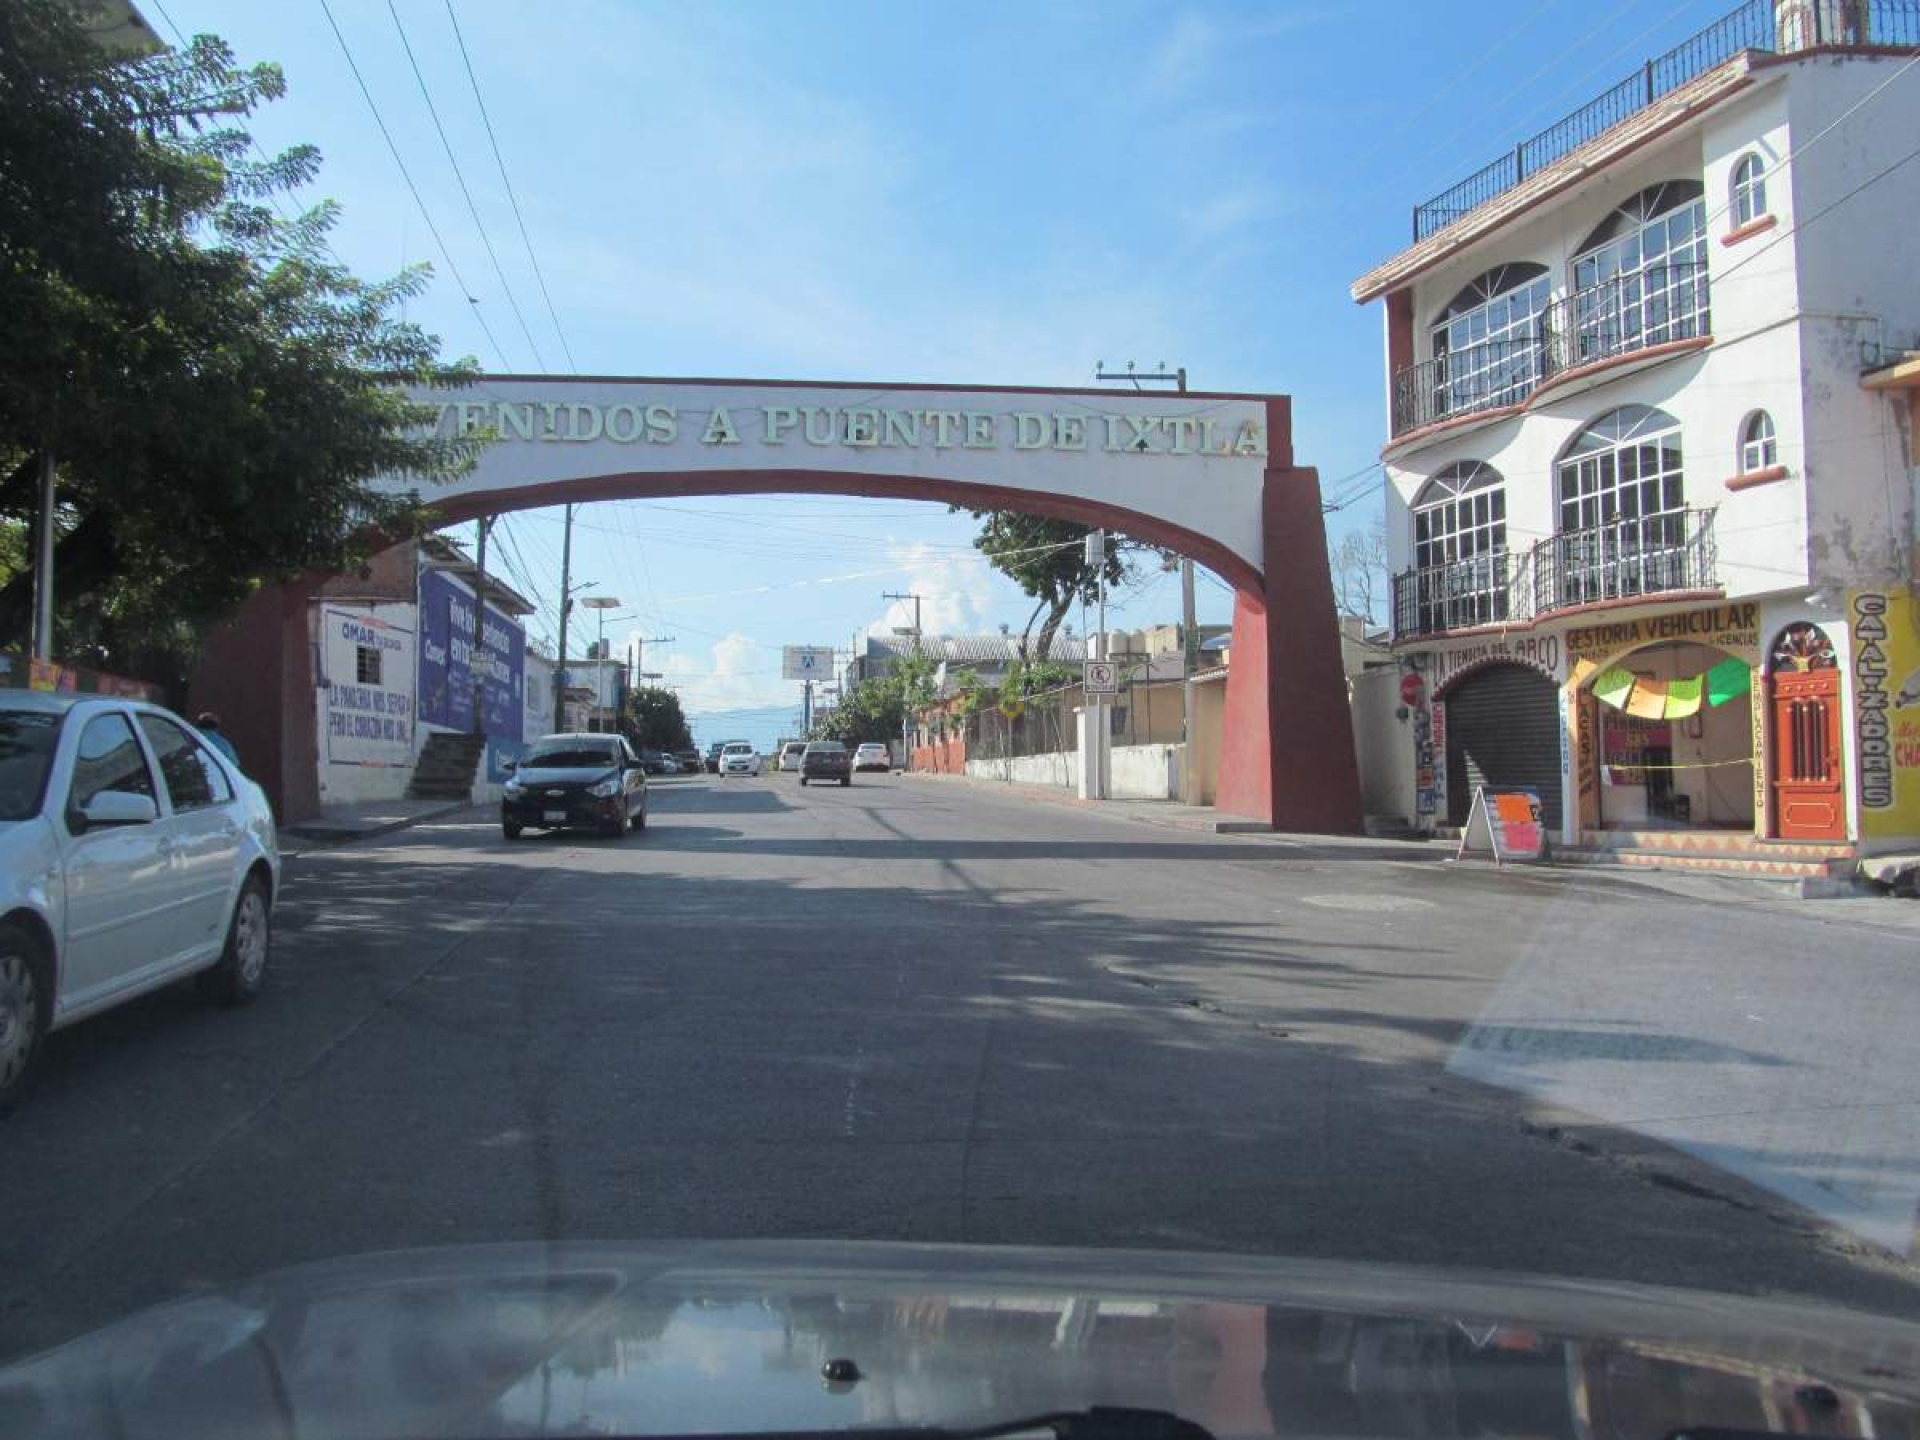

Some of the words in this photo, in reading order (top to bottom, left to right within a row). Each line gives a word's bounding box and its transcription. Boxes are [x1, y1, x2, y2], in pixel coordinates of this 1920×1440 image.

[702, 407, 741, 444] A
[763, 405, 998, 449] PUENTE
[1013, 411, 1088, 452] DE
[1103, 414, 1269, 457] IXTLA
[1566, 623, 1640, 650] GESTORIA
[1646, 603, 1756, 638] VEHICULAR
[1515, 634, 1558, 671] ARCO
[1853, 594, 1892, 808] CATALIZADORES
